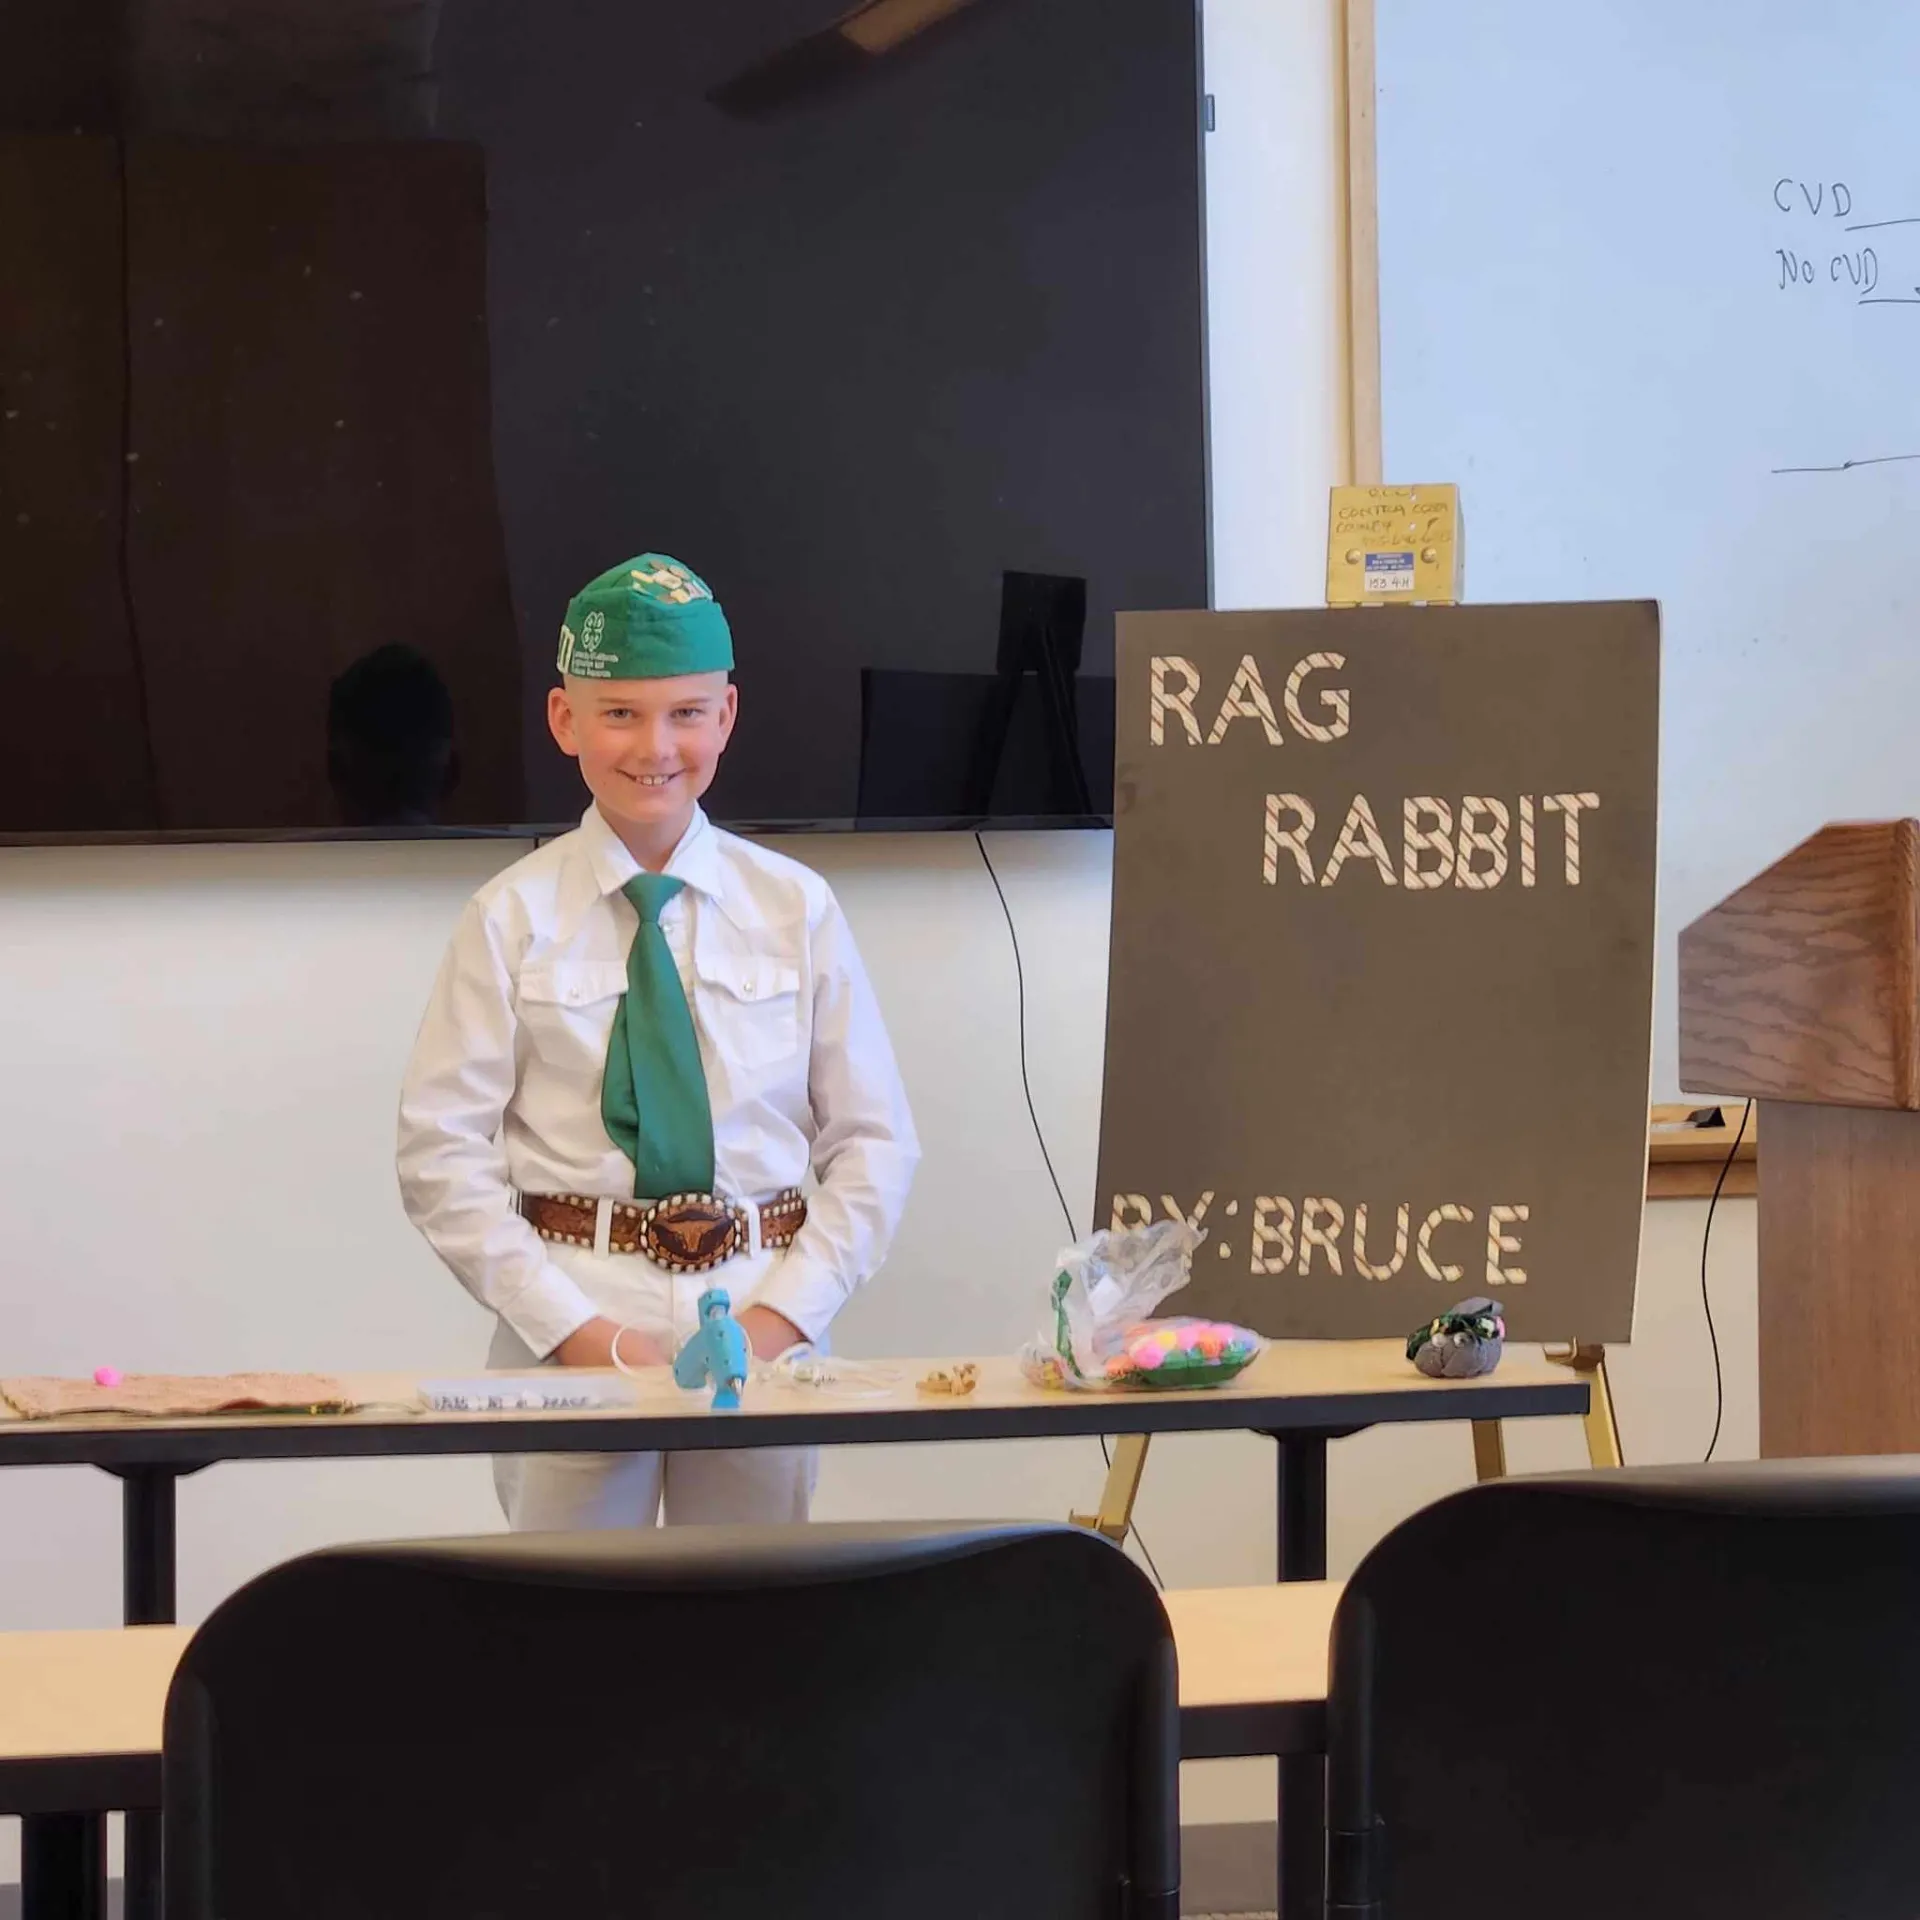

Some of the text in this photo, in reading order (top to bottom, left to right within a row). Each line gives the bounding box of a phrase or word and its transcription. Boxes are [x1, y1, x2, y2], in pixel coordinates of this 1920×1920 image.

[1773, 177, 1852, 218] CVD
[1775, 247, 1879, 297] No CVD
[1150, 651, 1351, 746] RAG
[1261, 791, 1601, 891] RABBIT
